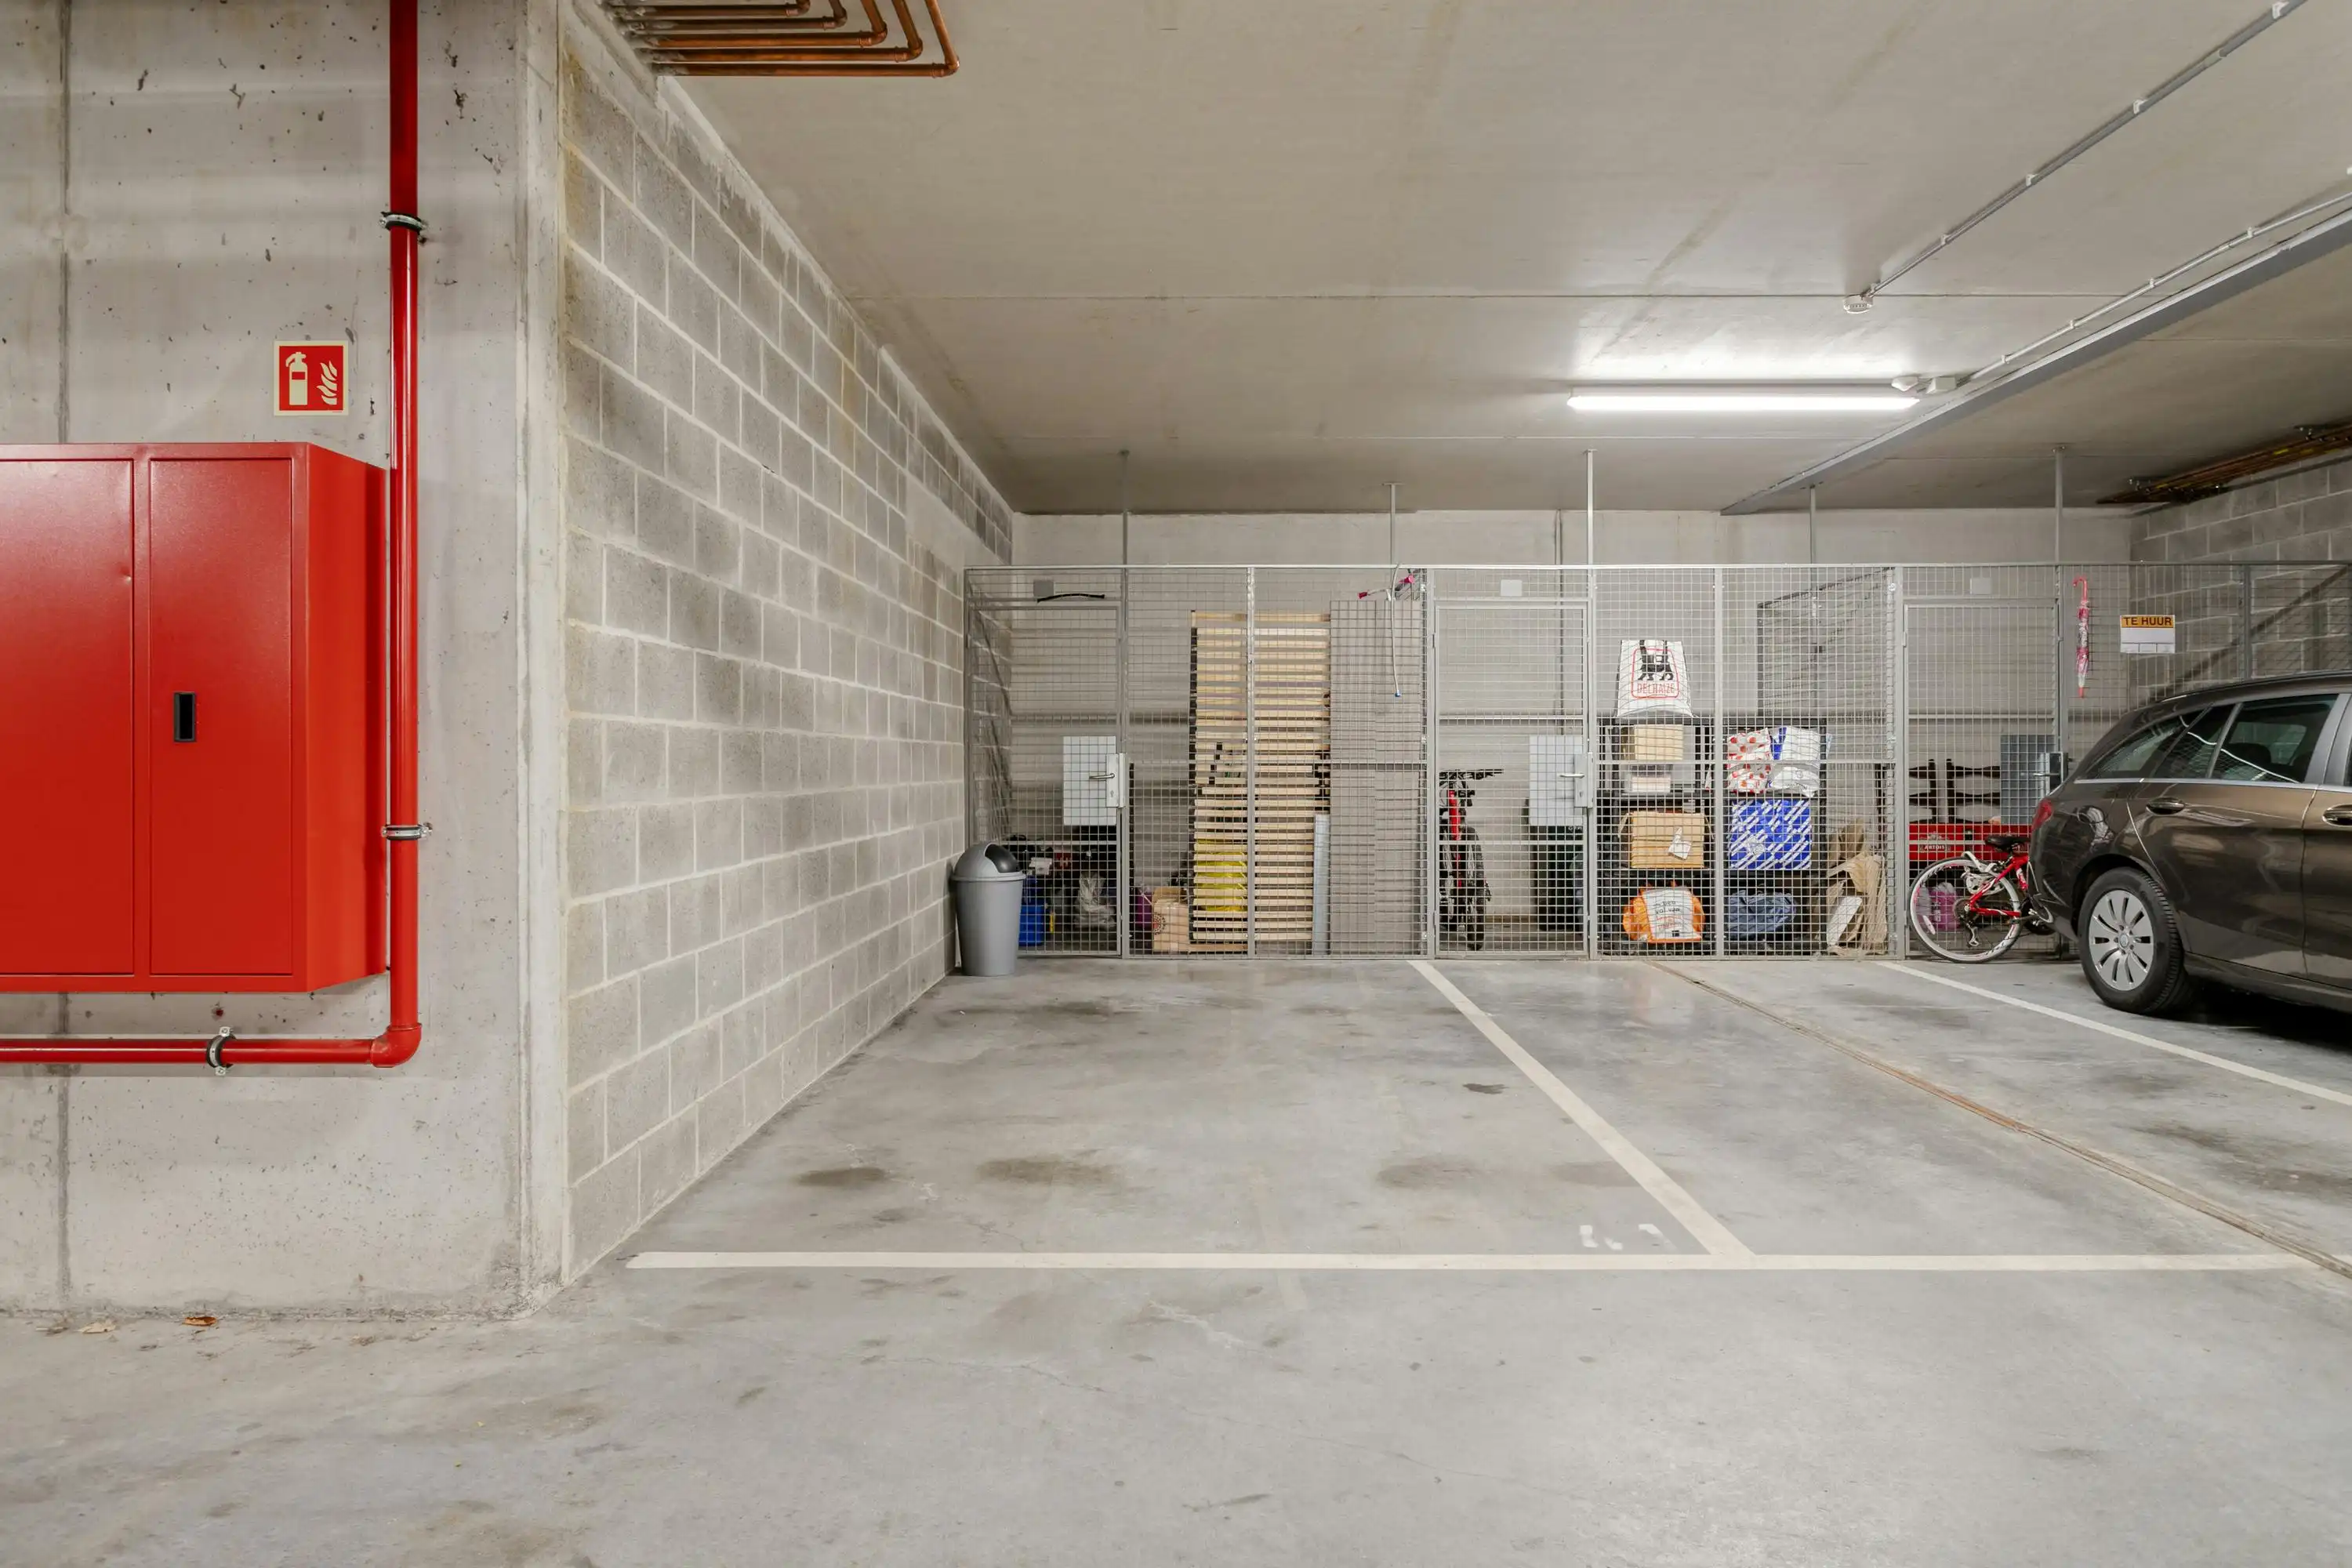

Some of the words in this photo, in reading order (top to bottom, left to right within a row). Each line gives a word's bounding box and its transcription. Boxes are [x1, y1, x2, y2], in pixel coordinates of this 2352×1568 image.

[2123, 617, 2138, 626] TE
[2141, 617, 2172, 626] HUUR
[1637, 683, 1675, 694] DELHAIZE
